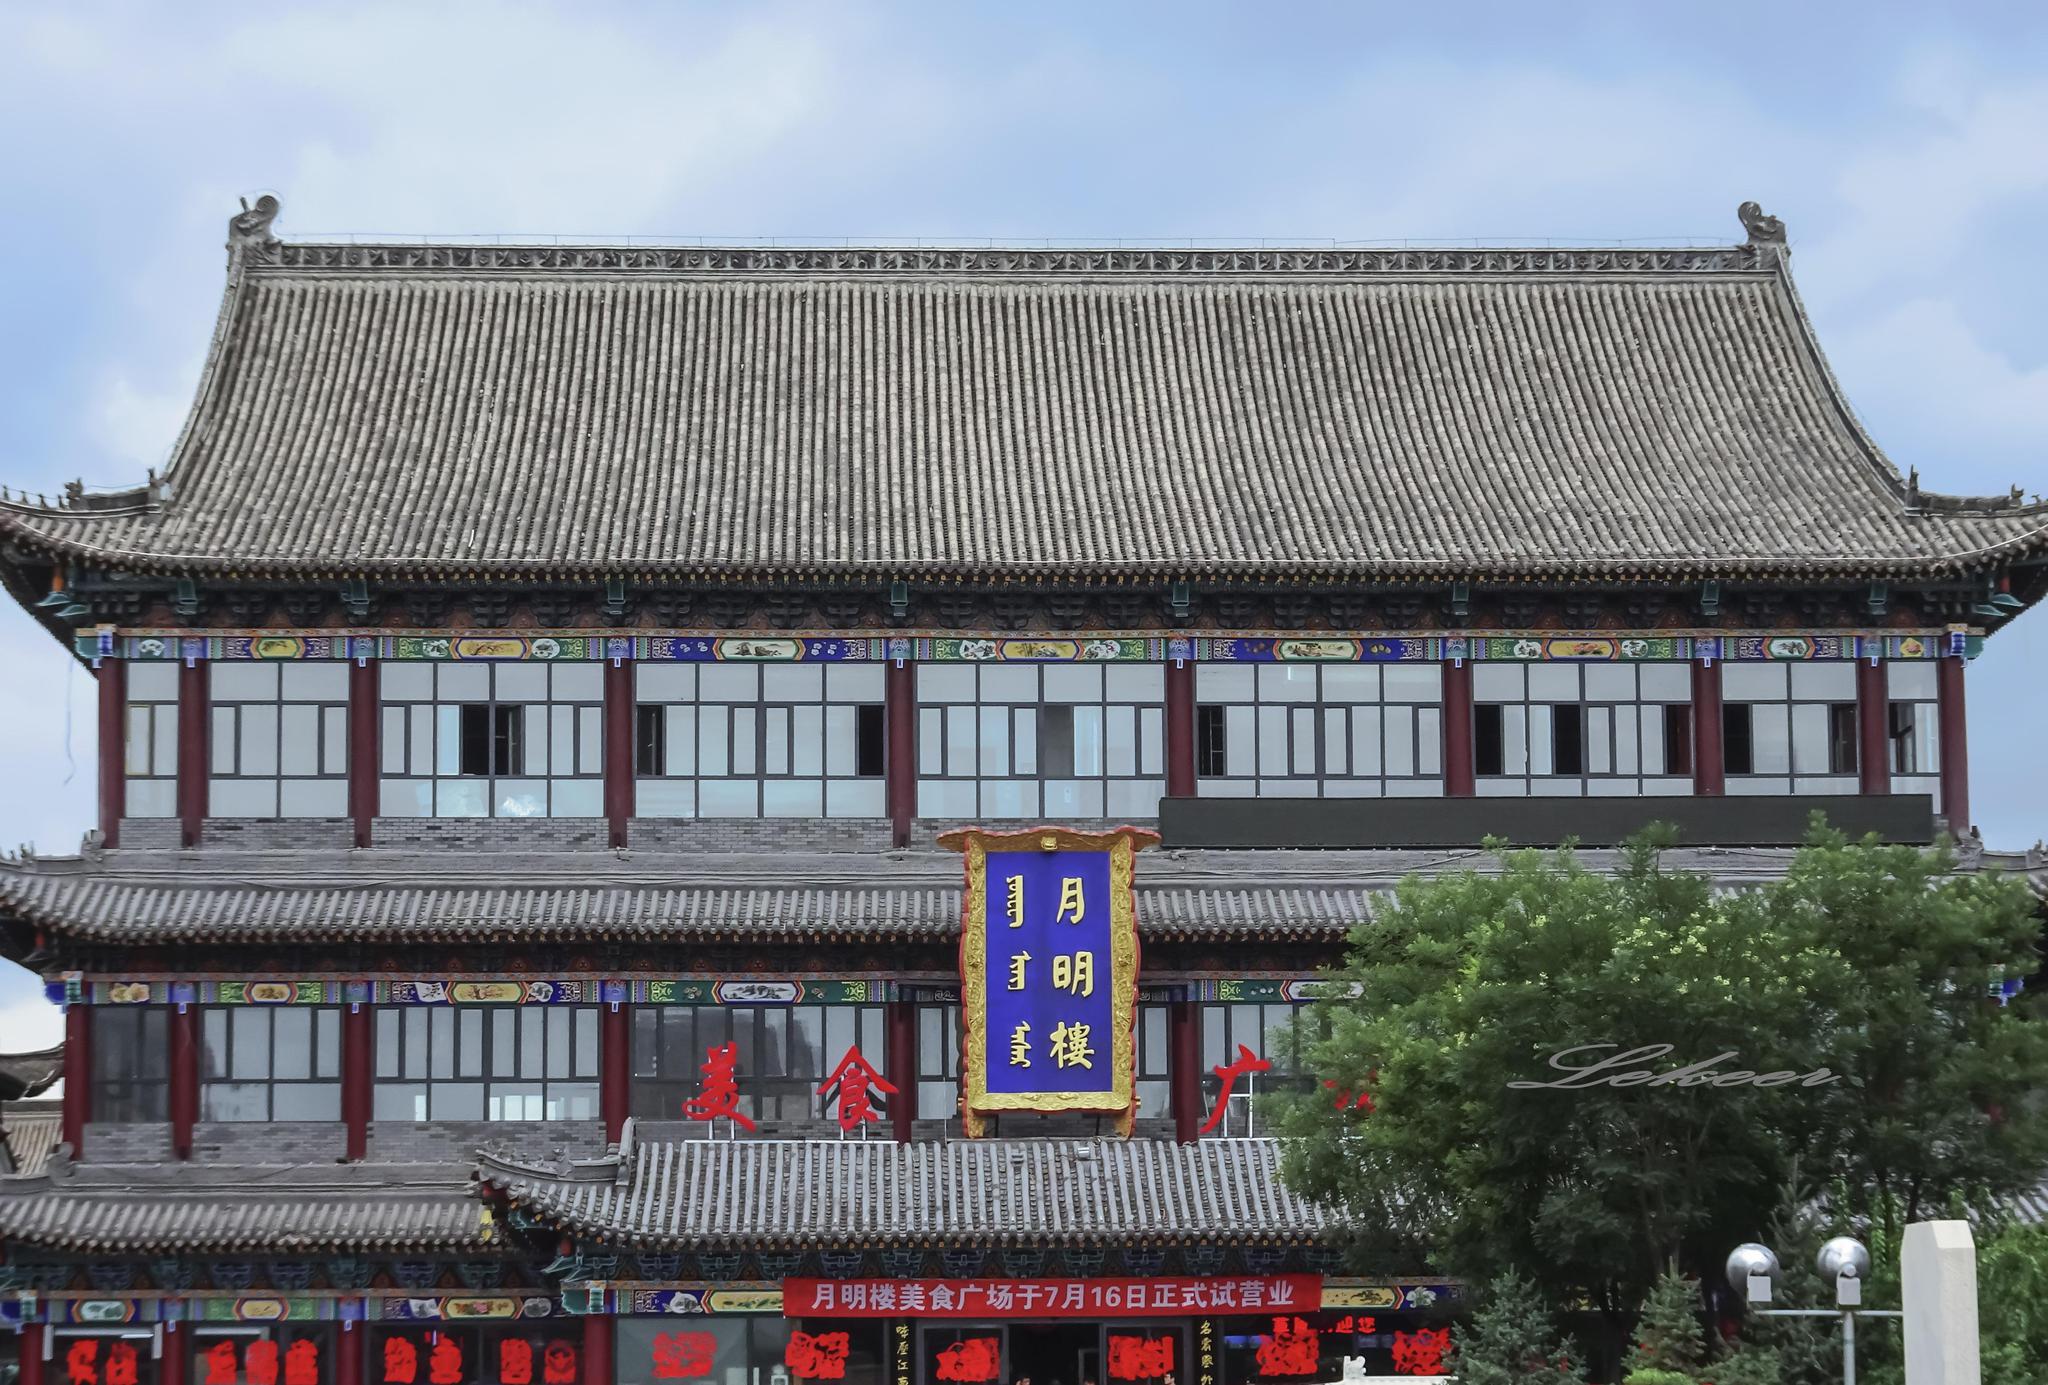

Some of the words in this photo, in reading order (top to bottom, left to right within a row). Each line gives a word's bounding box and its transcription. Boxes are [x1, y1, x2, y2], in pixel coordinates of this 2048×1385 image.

[681, 1040, 899, 1133] 美食
[811, 1280, 1294, 1311] 月明楼美食广场于7月16日正式试营业
